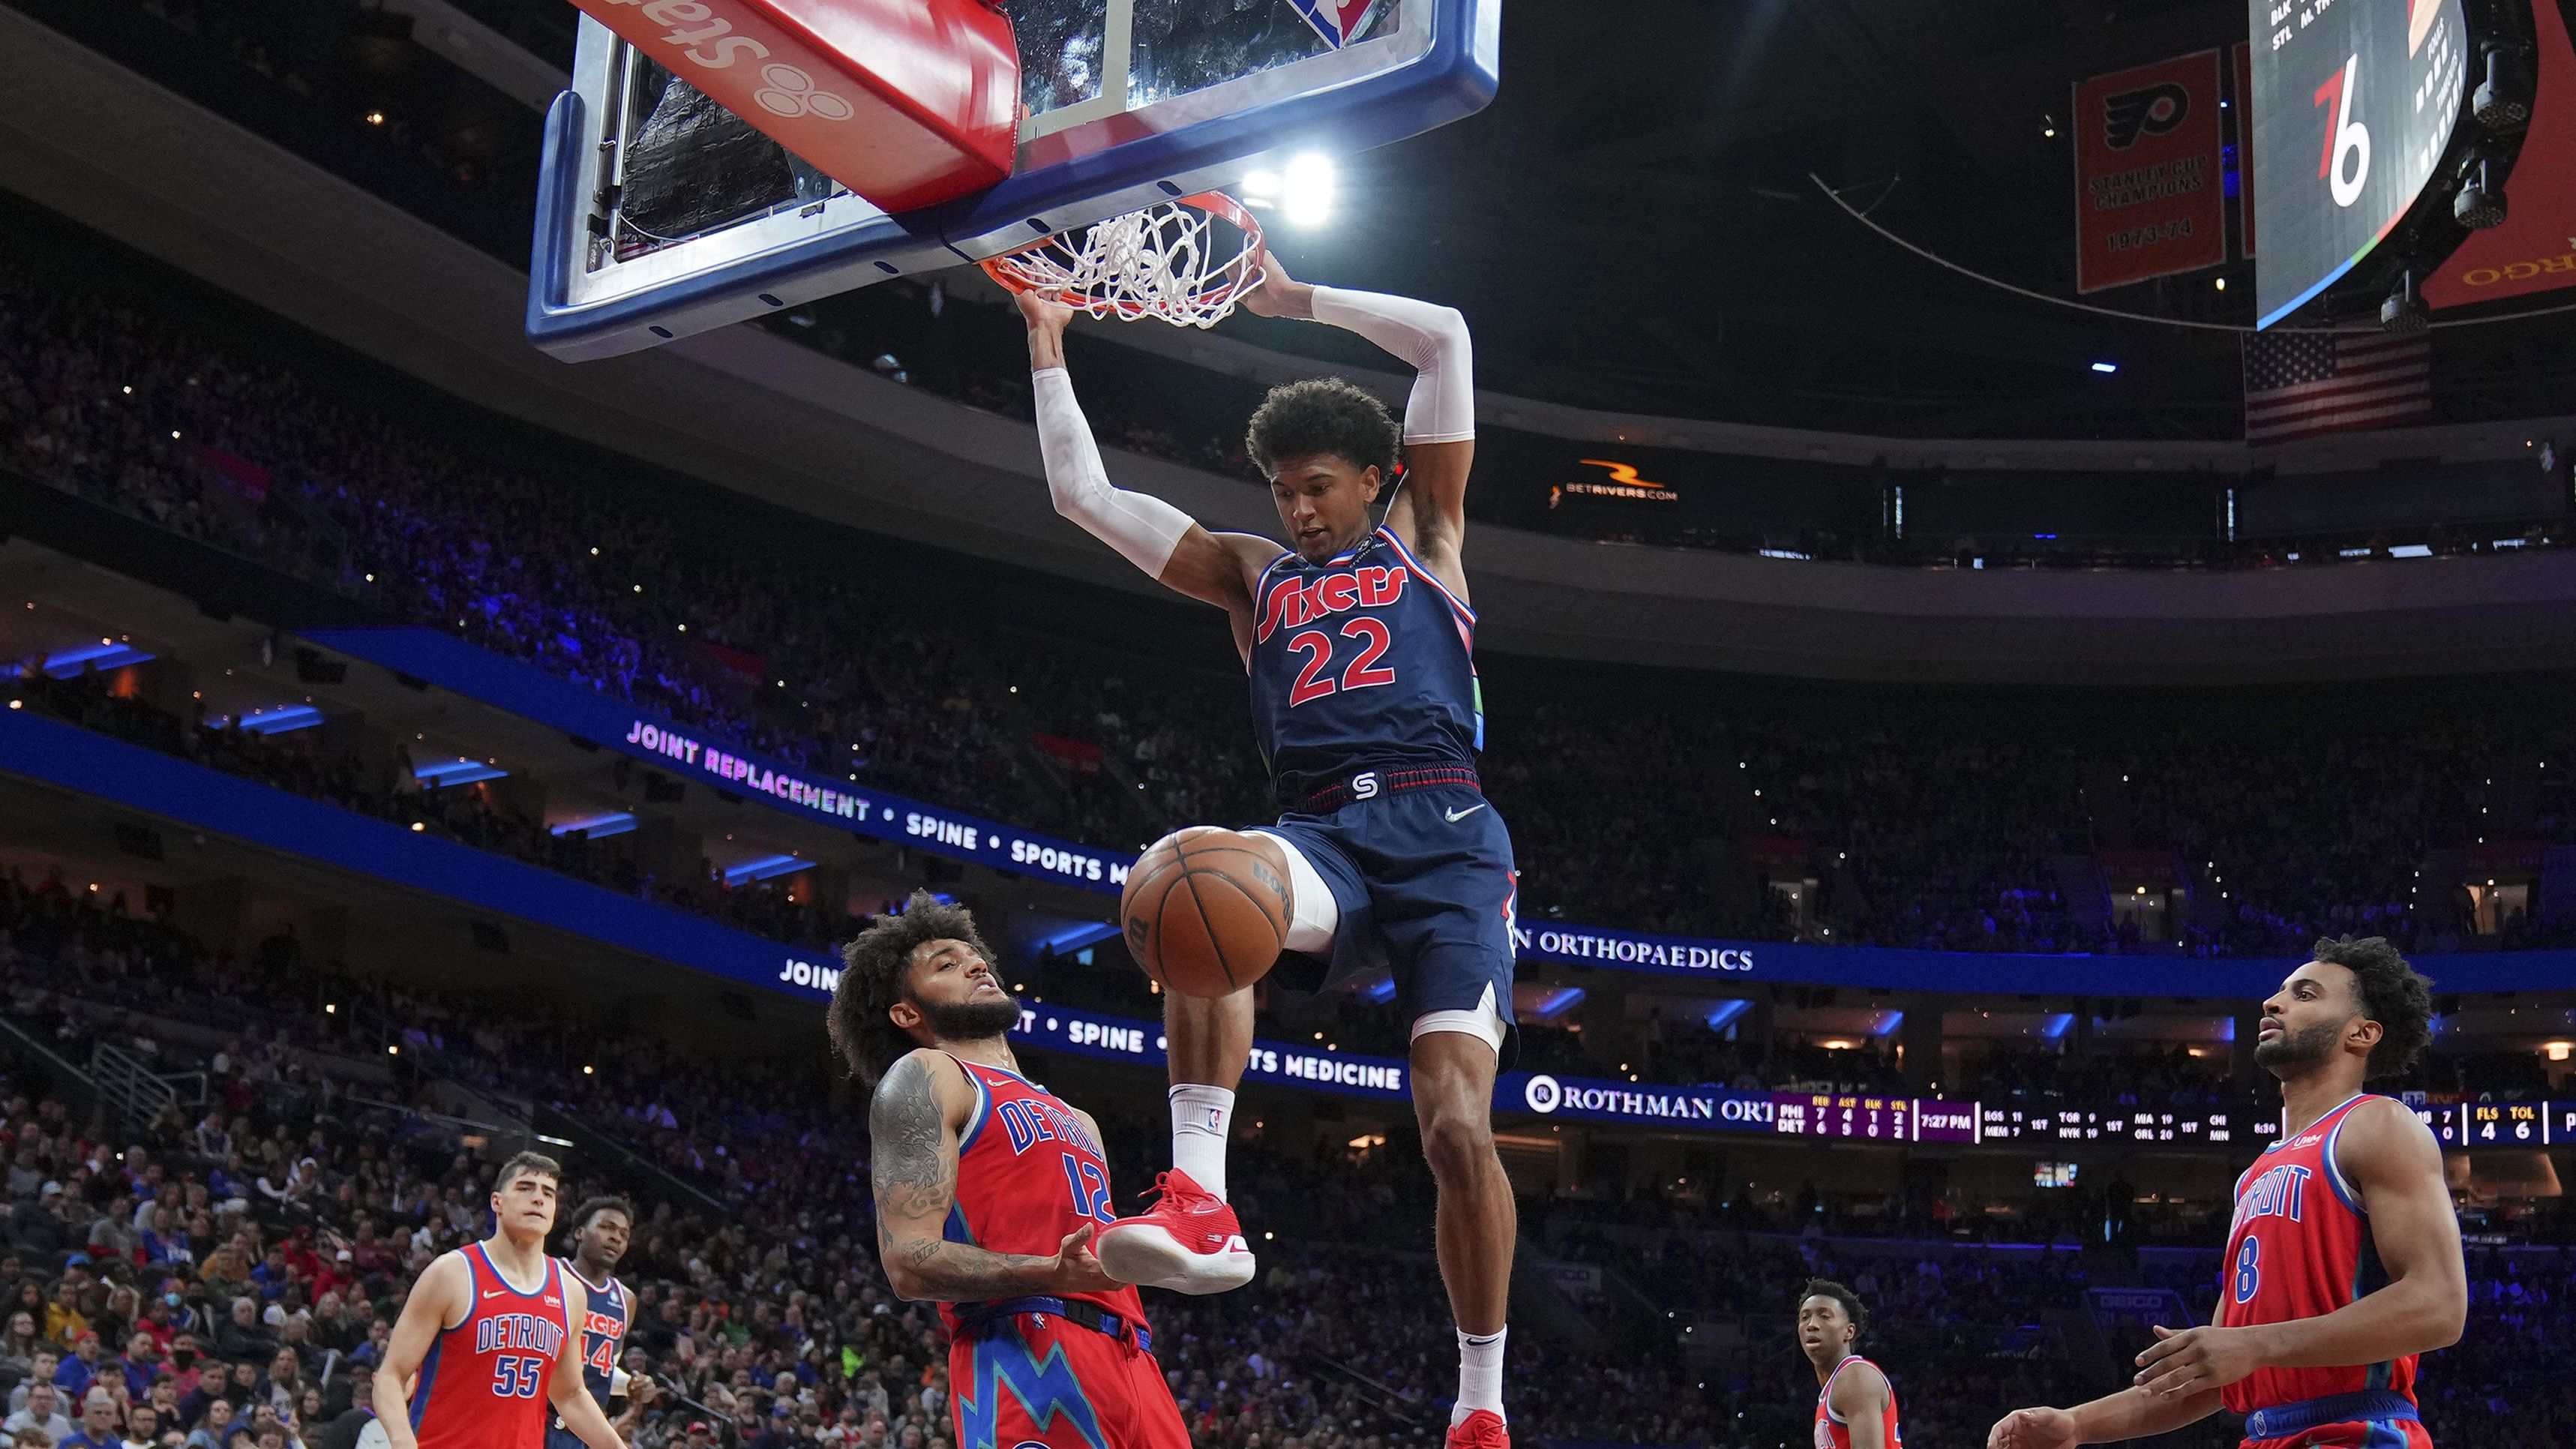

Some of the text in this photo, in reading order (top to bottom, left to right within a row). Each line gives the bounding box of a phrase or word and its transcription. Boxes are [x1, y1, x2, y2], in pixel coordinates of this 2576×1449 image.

[598, 0, 771, 69] Sta
[2272, 26, 2293, 51] STL
[2090, 154, 2208, 194] STANLEY CUP
[2094, 176, 2202, 212] CHAMPIONS
[2107, 218, 2192, 253] 1973-74
[1287, 616, 1396, 709] 22
[626, 719, 699, 765] JOINT
[703, 747, 871, 822] REPLACEMENT
[906, 812, 978, 850] SPINE
[1011, 838, 1102, 881] SPORTS
[1539, 931, 1754, 972] ORTHOPAEDICS
[779, 958, 839, 993] JOIN
[1068, 1019, 1145, 1054] SPINE
[1285, 1054, 1402, 1090] MEDICINE
[1562, 1085, 1715, 1120] ROTHMAN
[1838, 1096, 1858, 1108] AST
[1891, 1100, 1908, 1112] STL
[2476, 1106, 2535, 1120] FLS TOL
[1780, 1104, 1904, 1125] PHI 7 4 1 2
[1920, 1114, 1972, 1130] 7:27 PM
[2012, 1112, 2023, 1123] 11
[2031, 1118, 2049, 1131] 1ST
[2059, 1112, 2081, 1124] TOR
[2134, 1113, 2155, 1125] MIA
[2209, 1114, 2227, 1126] CHI
[2443, 1110, 2452, 1124] 7
[997, 1098, 1104, 1162] DETRO
[1777, 1118, 1904, 1139] DET 6 5 0 2
[1984, 1126, 2021, 1138] MEM 7
[2059, 1127, 2082, 1139] NYK
[2106, 1120, 2124, 1132] 1ST
[2134, 1129, 2173, 1141] ORL 20
[2181, 1121, 2199, 1133] 1ST
[2209, 1130, 2230, 1142] MIN
[2443, 1126, 2454, 1140] 0
[2481, 1120, 2531, 1140] 4 6
[1062, 1152, 1117, 1226] 12
[2235, 1234, 2260, 1305] 8
[475, 1312, 564, 1363] DETROIT
[492, 1354, 544, 1399] 55
